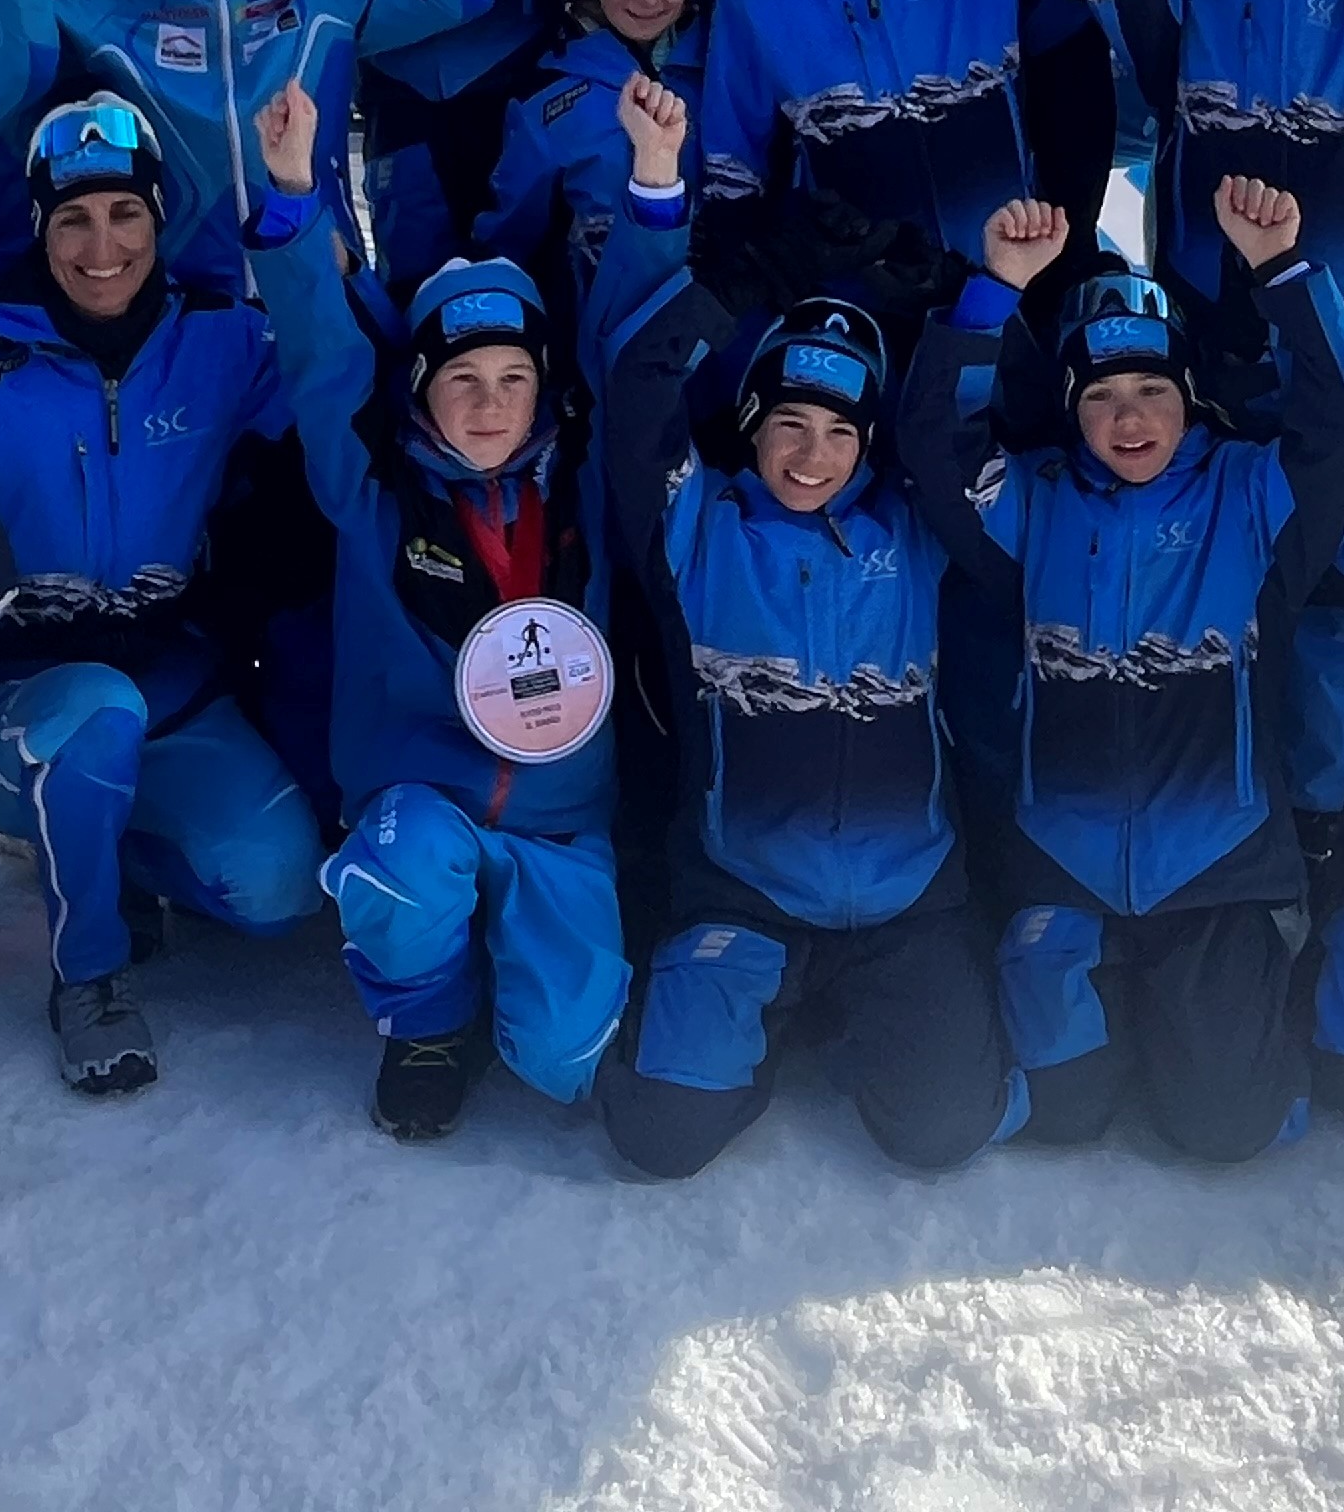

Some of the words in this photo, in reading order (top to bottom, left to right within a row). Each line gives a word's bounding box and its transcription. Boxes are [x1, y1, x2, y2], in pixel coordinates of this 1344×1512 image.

[452, 293, 493, 316] SSC
[1098, 318, 1141, 339] SSC
[798, 348, 838, 373] SSC
[144, 407, 187, 439] SSC
[1156, 521, 1194, 546] SSC
[859, 548, 897, 574] SSC
